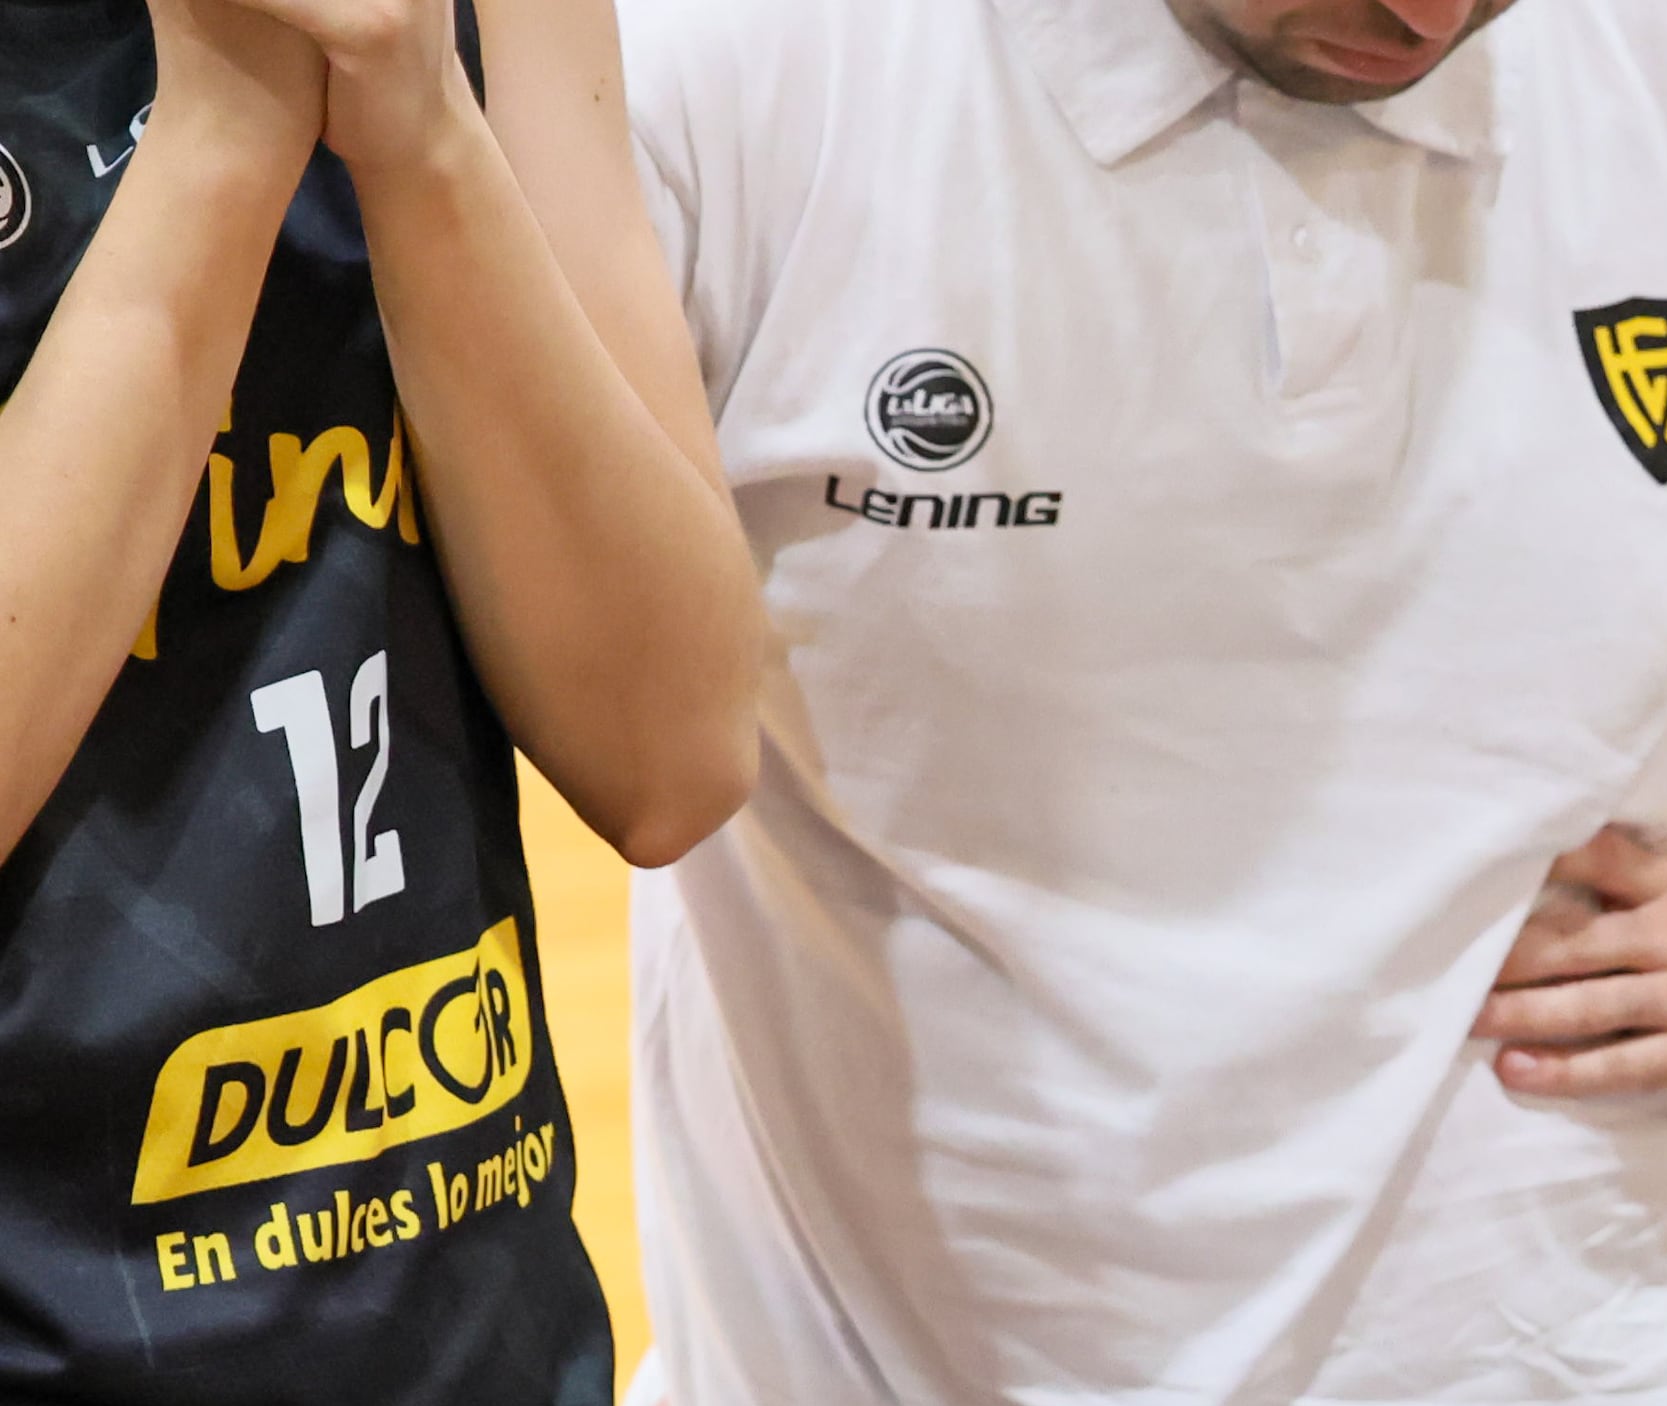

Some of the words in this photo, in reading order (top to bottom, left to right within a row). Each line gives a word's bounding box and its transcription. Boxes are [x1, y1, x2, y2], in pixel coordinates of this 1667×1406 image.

[826, 475, 1062, 530] LENING
[250, 649, 405, 927] 12
[187, 955, 518, 1168] DULCOR
[156, 1231, 237, 1291] En
[254, 1189, 420, 1271] dulces
[427, 1161, 468, 1229] lo
[475, 1114, 555, 1208] mejor
